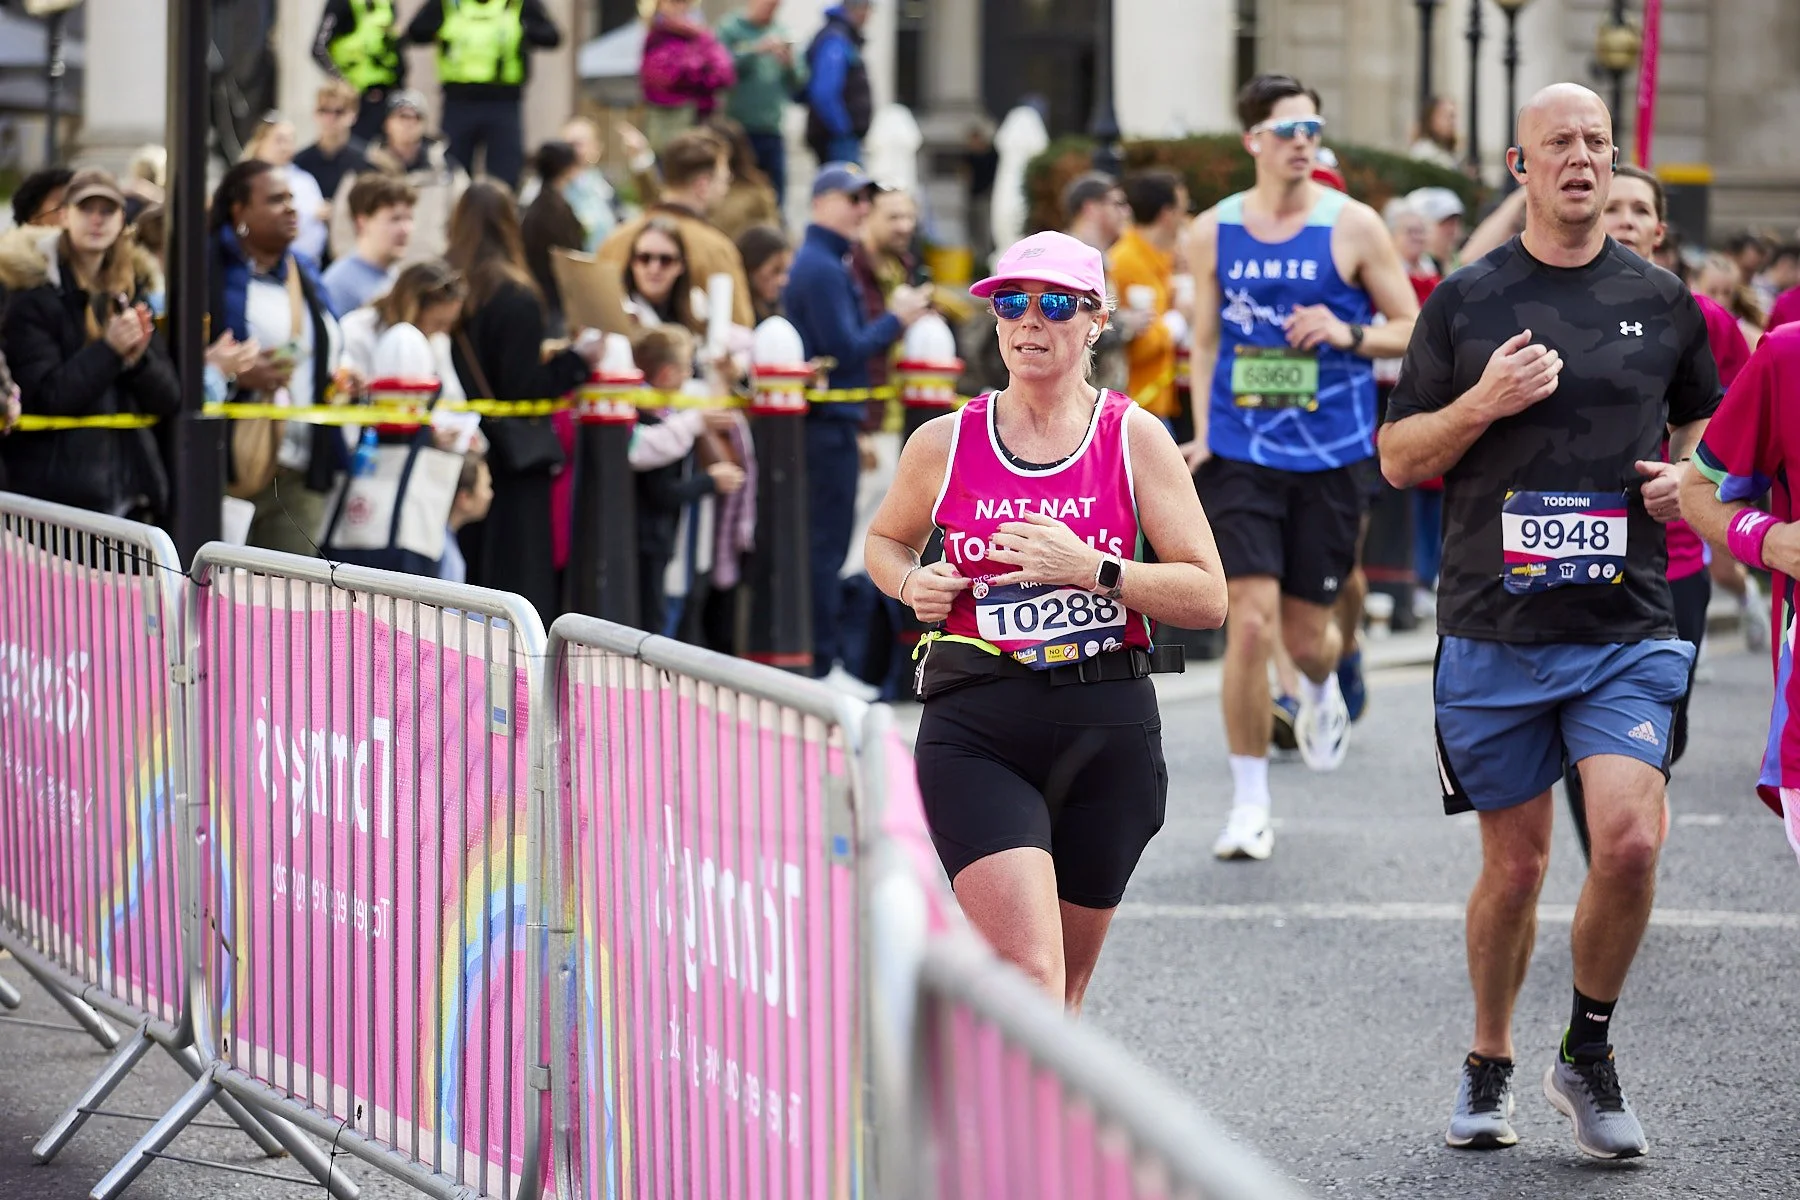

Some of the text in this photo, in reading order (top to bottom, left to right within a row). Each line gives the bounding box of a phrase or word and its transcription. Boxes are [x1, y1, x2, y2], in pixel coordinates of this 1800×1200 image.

[1228, 259, 1318, 281] JAMIE
[974, 497, 1096, 521] NAT NAT
[1542, 496, 1590, 507] TODDINI
[1521, 519, 1609, 550] 9948
[988, 592, 1118, 636] 10288
[1628, 730, 1659, 746] adidas
